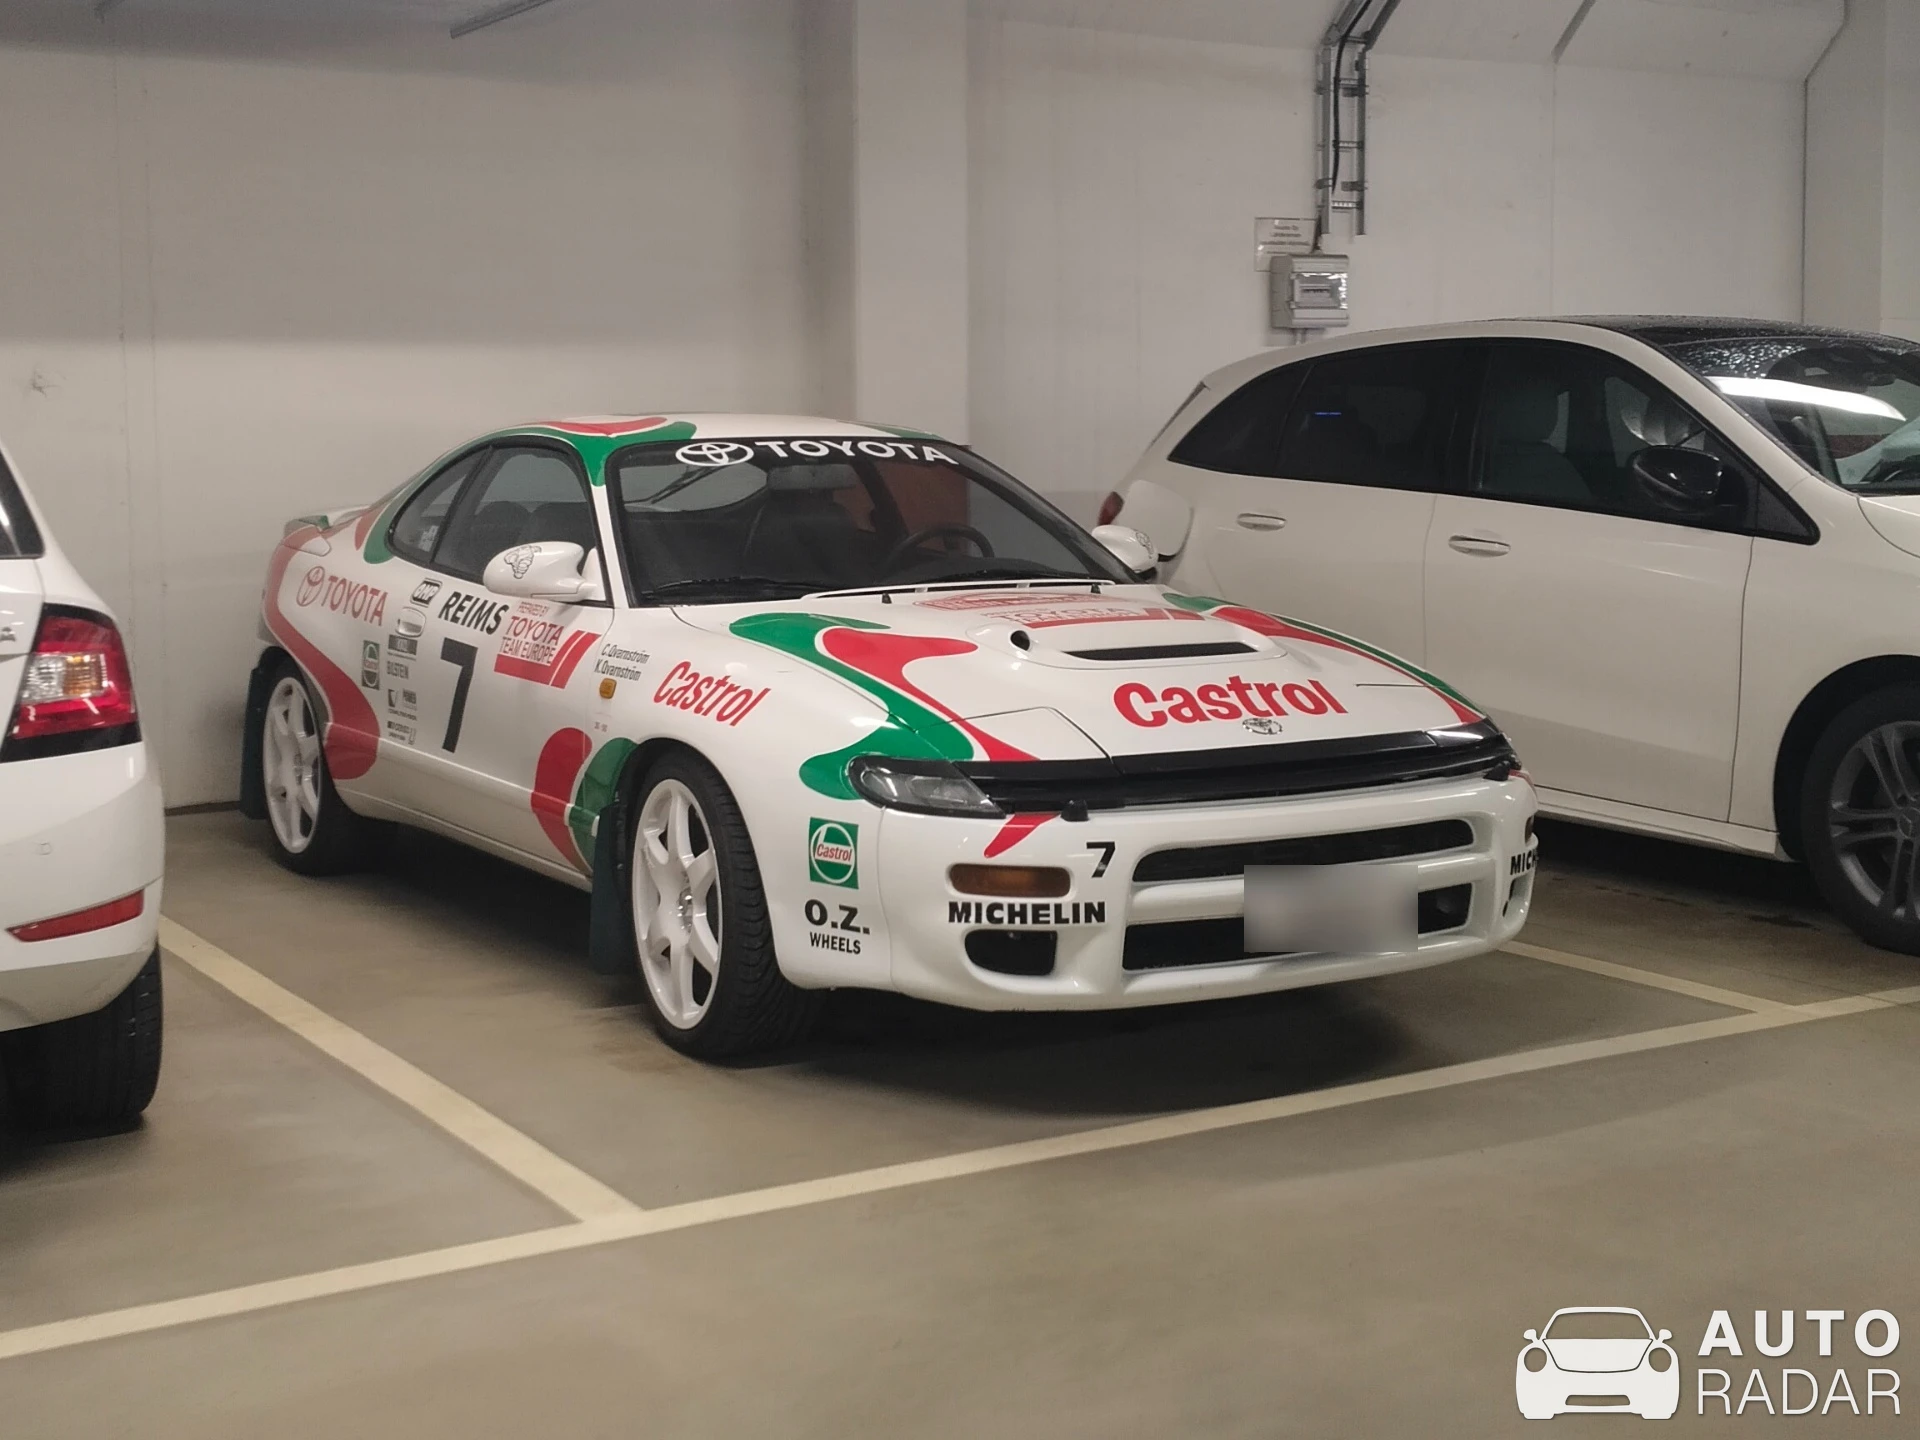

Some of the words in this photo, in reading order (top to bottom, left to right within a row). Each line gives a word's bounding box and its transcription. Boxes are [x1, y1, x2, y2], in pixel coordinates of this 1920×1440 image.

[754, 440, 959, 465] TOYOTA
[321, 575, 388, 626] TOYOTA
[438, 591, 510, 635] REIMS
[505, 615, 565, 646] TOYOTA
[500, 636, 524, 655] TEAM
[520, 641, 556, 665] EUROPE
[440, 637, 478, 753] 7
[653, 661, 771, 726] Castrol
[1113, 675, 1349, 728] Castrol
[816, 843, 853, 862] Castrol
[1086, 841, 1116, 878] 7
[804, 899, 870, 934] O.Z.
[948, 901, 1106, 924] MICHELIN
[809, 931, 861, 954] WHEELS
